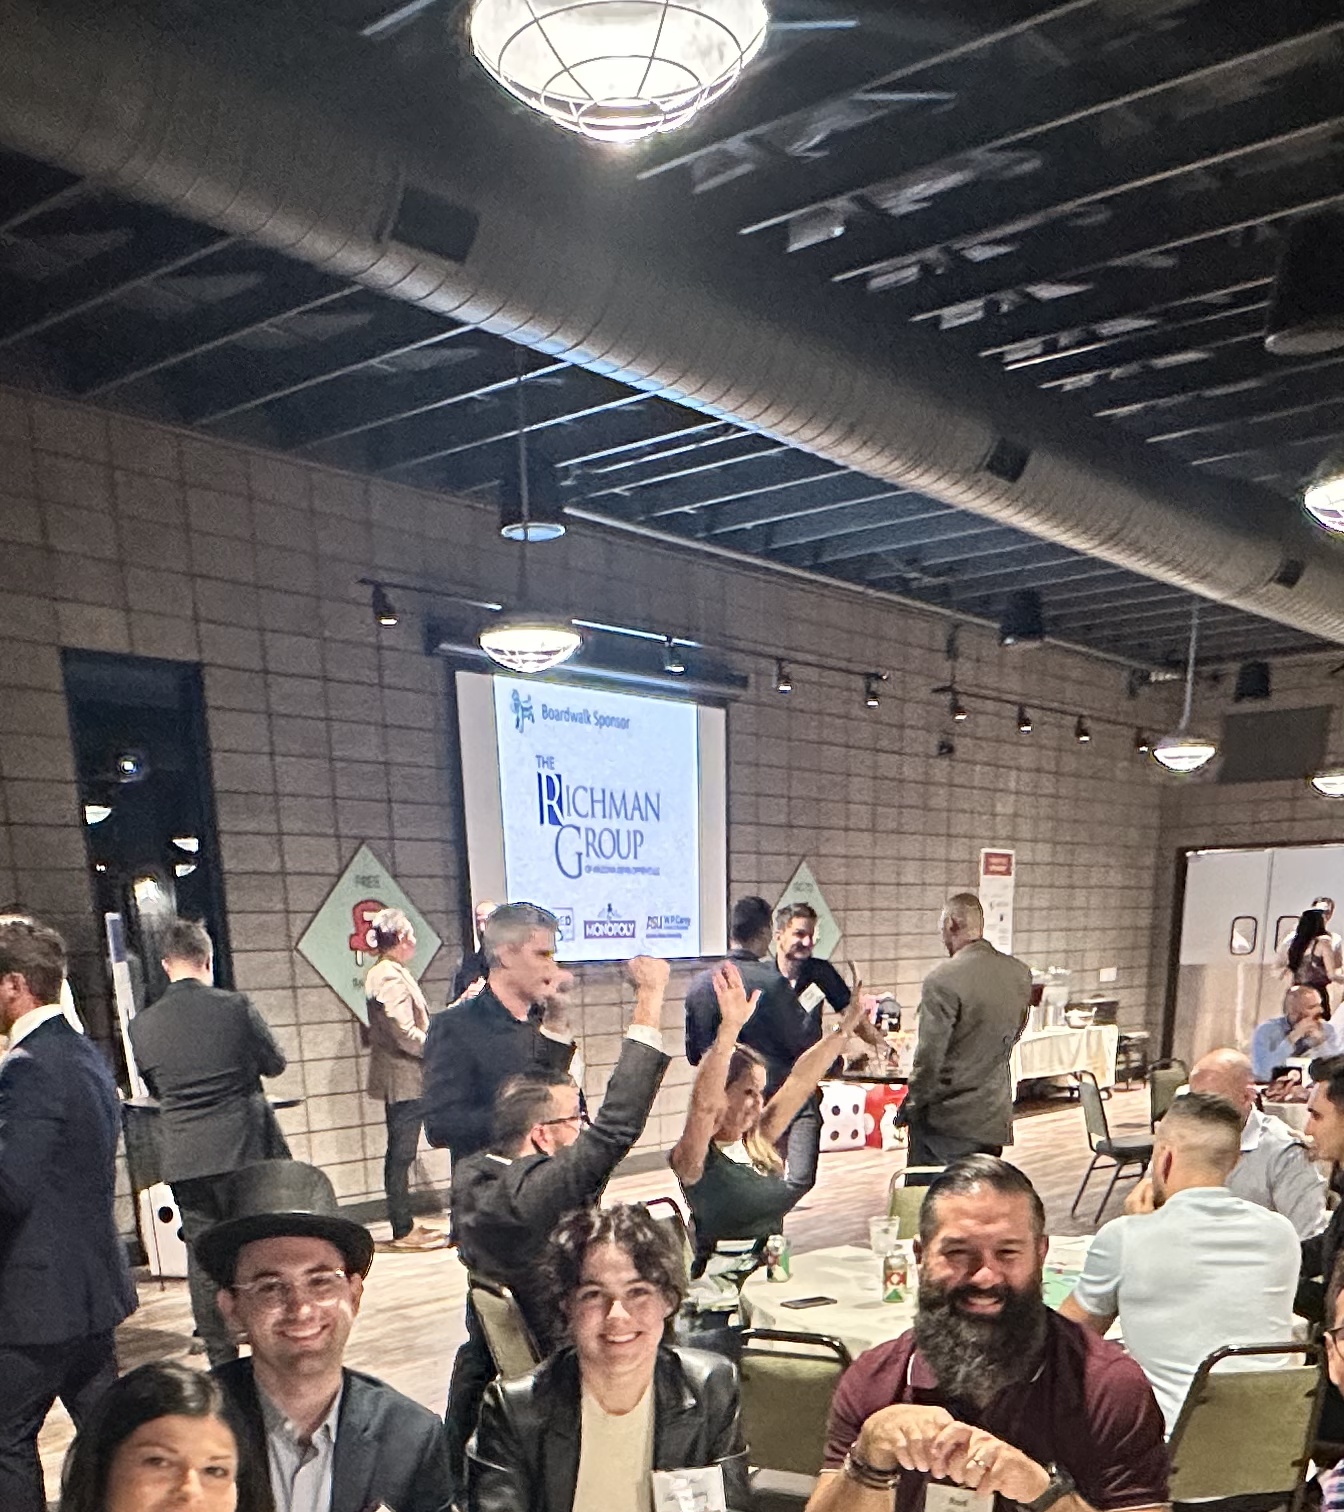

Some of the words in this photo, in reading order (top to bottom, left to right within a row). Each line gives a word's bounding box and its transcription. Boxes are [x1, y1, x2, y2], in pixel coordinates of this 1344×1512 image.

[541, 703, 591, 725] Boardwalk
[593, 709, 631, 730] Sponsor
[535, 754, 555, 770] THE
[537, 771, 661, 826] RICHMAN
[554, 823, 645, 880] GROUP
[585, 921, 635, 937] MONOPOLY
[646, 915, 662, 930] ASU
